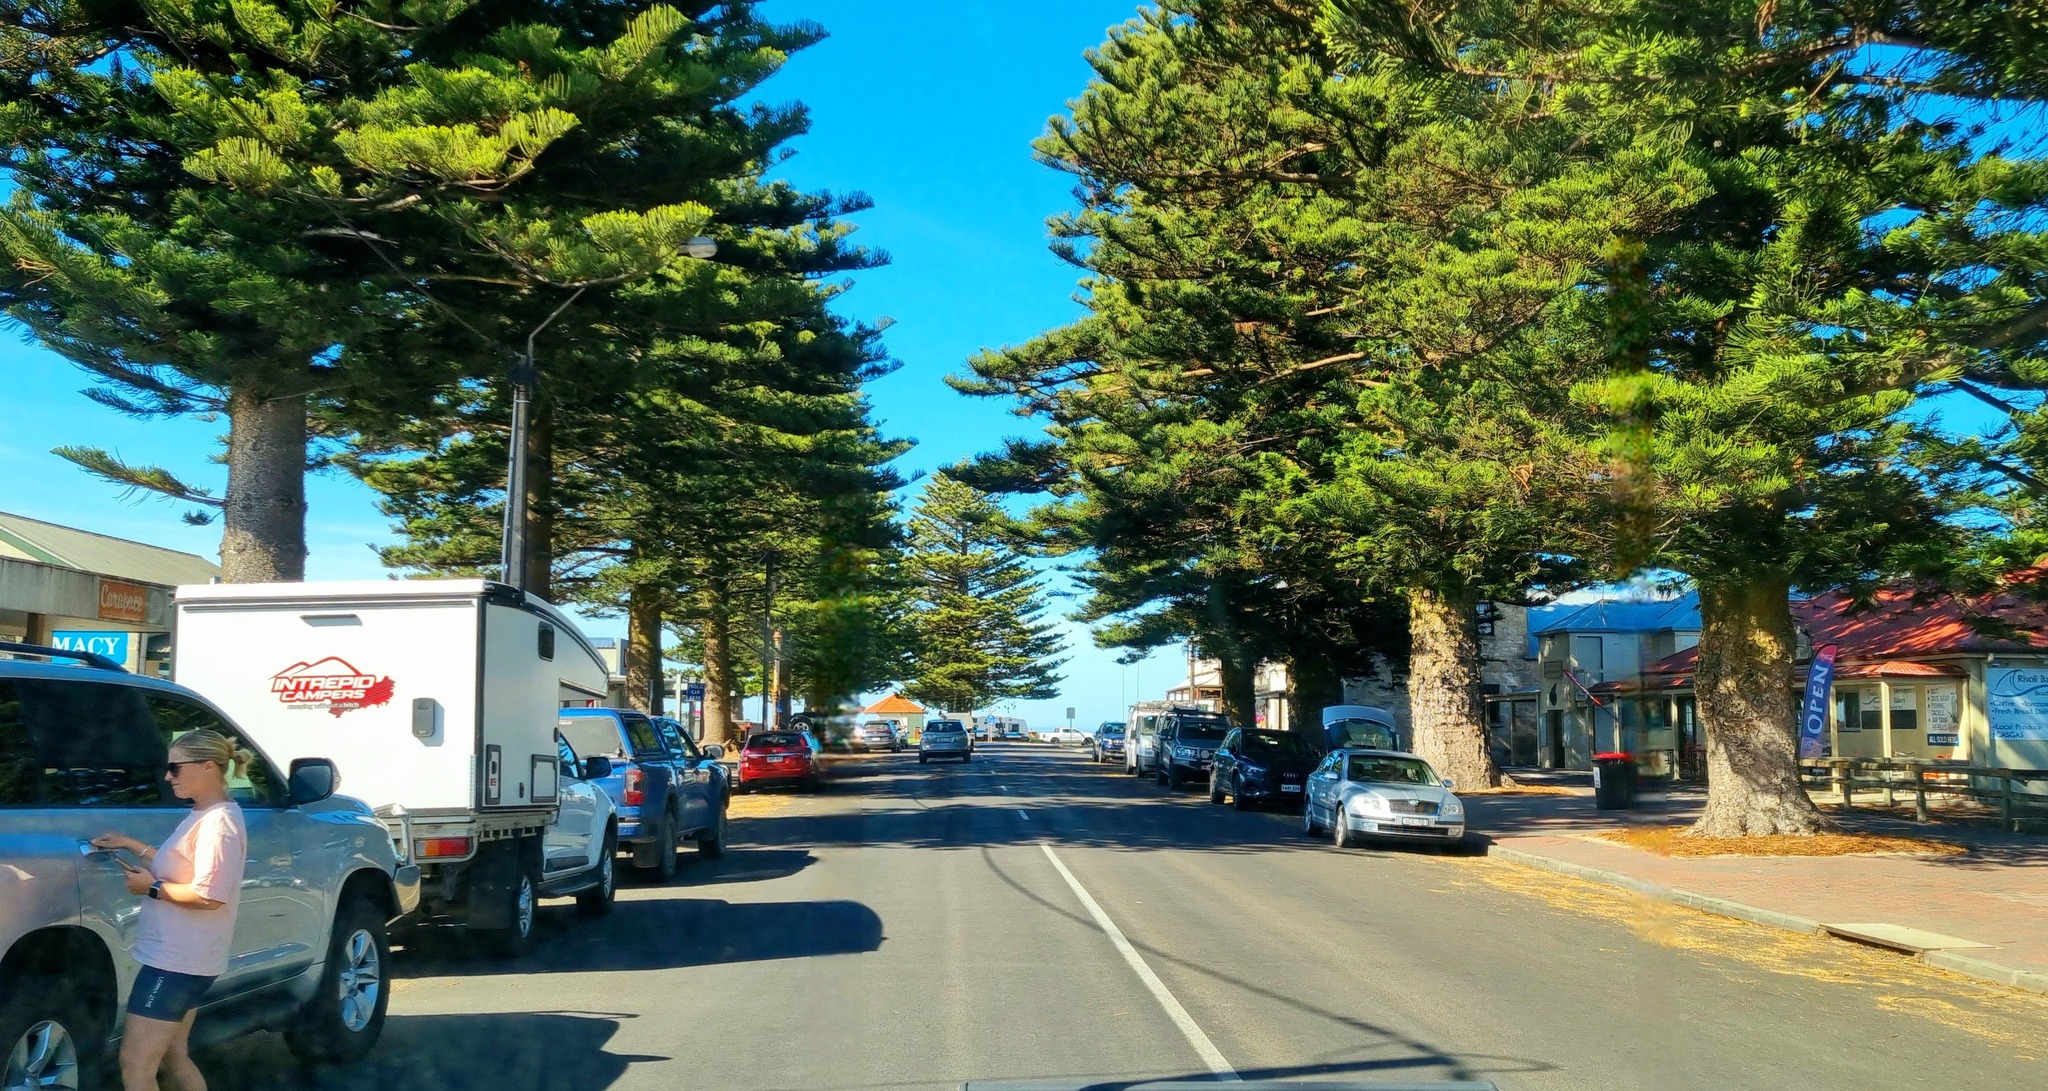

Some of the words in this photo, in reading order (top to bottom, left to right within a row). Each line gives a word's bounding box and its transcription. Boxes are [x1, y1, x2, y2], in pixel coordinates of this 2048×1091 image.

[52, 636, 120, 655] MACY
[274, 677, 375, 690] INTREPID
[2017, 674, 2038, 683] Rivoli
[2040, 674, 2048, 683] Ba
[281, 689, 366, 700] CAMPERS
[1807, 664, 1829, 735] OPEN
